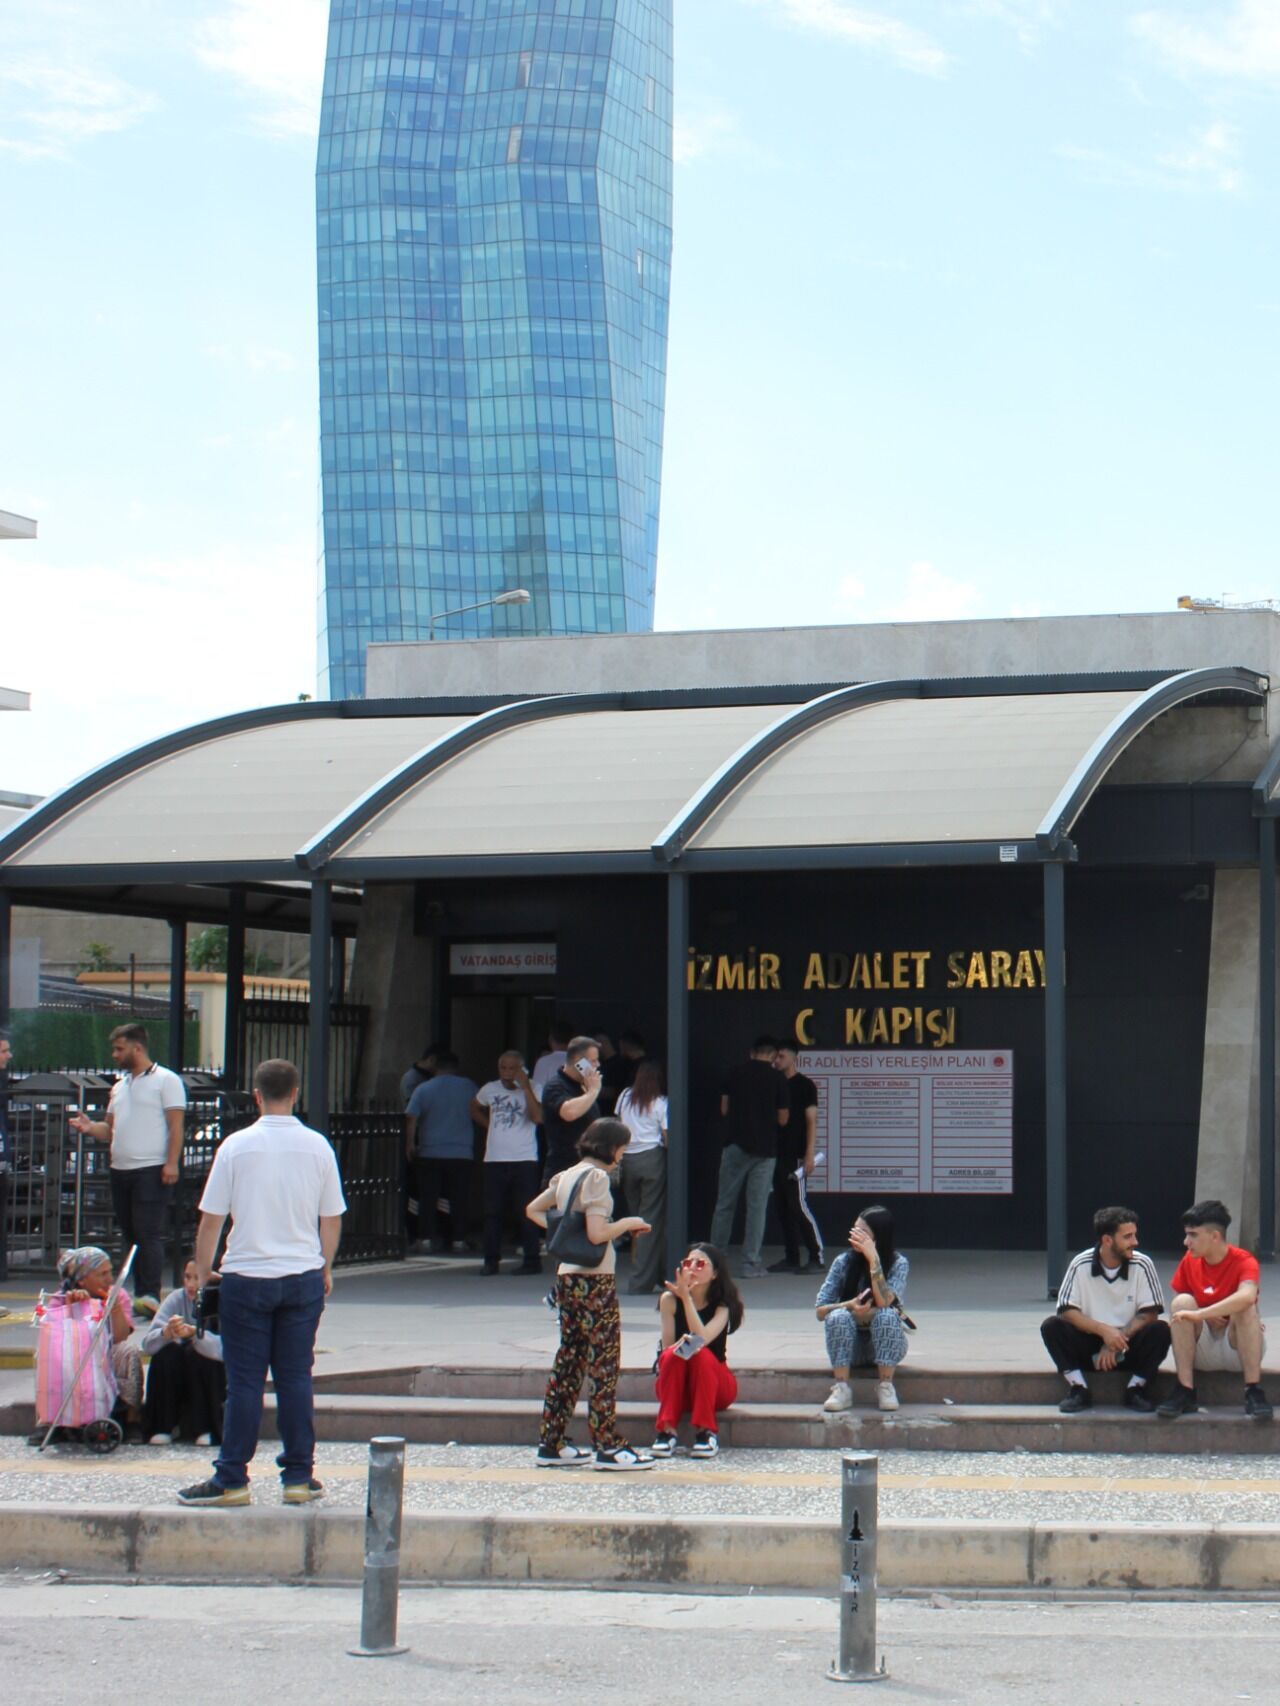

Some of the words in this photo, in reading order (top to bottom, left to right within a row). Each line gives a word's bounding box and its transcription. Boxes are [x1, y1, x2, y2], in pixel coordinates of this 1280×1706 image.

[460, 954, 522, 968] VATANDAŞ
[687, 947, 781, 991] İZMİR
[803, 952, 931, 990] ADALET
[946, 949, 1066, 989] SARAY
[795, 1008, 815, 1046] C
[815, 1055, 872, 1068] ADLİYESİ
[877, 1055, 943, 1070] YERLEŞİM
[947, 1056, 986, 1067] PLANI
[850, 1543, 860, 1613] İZMİR
